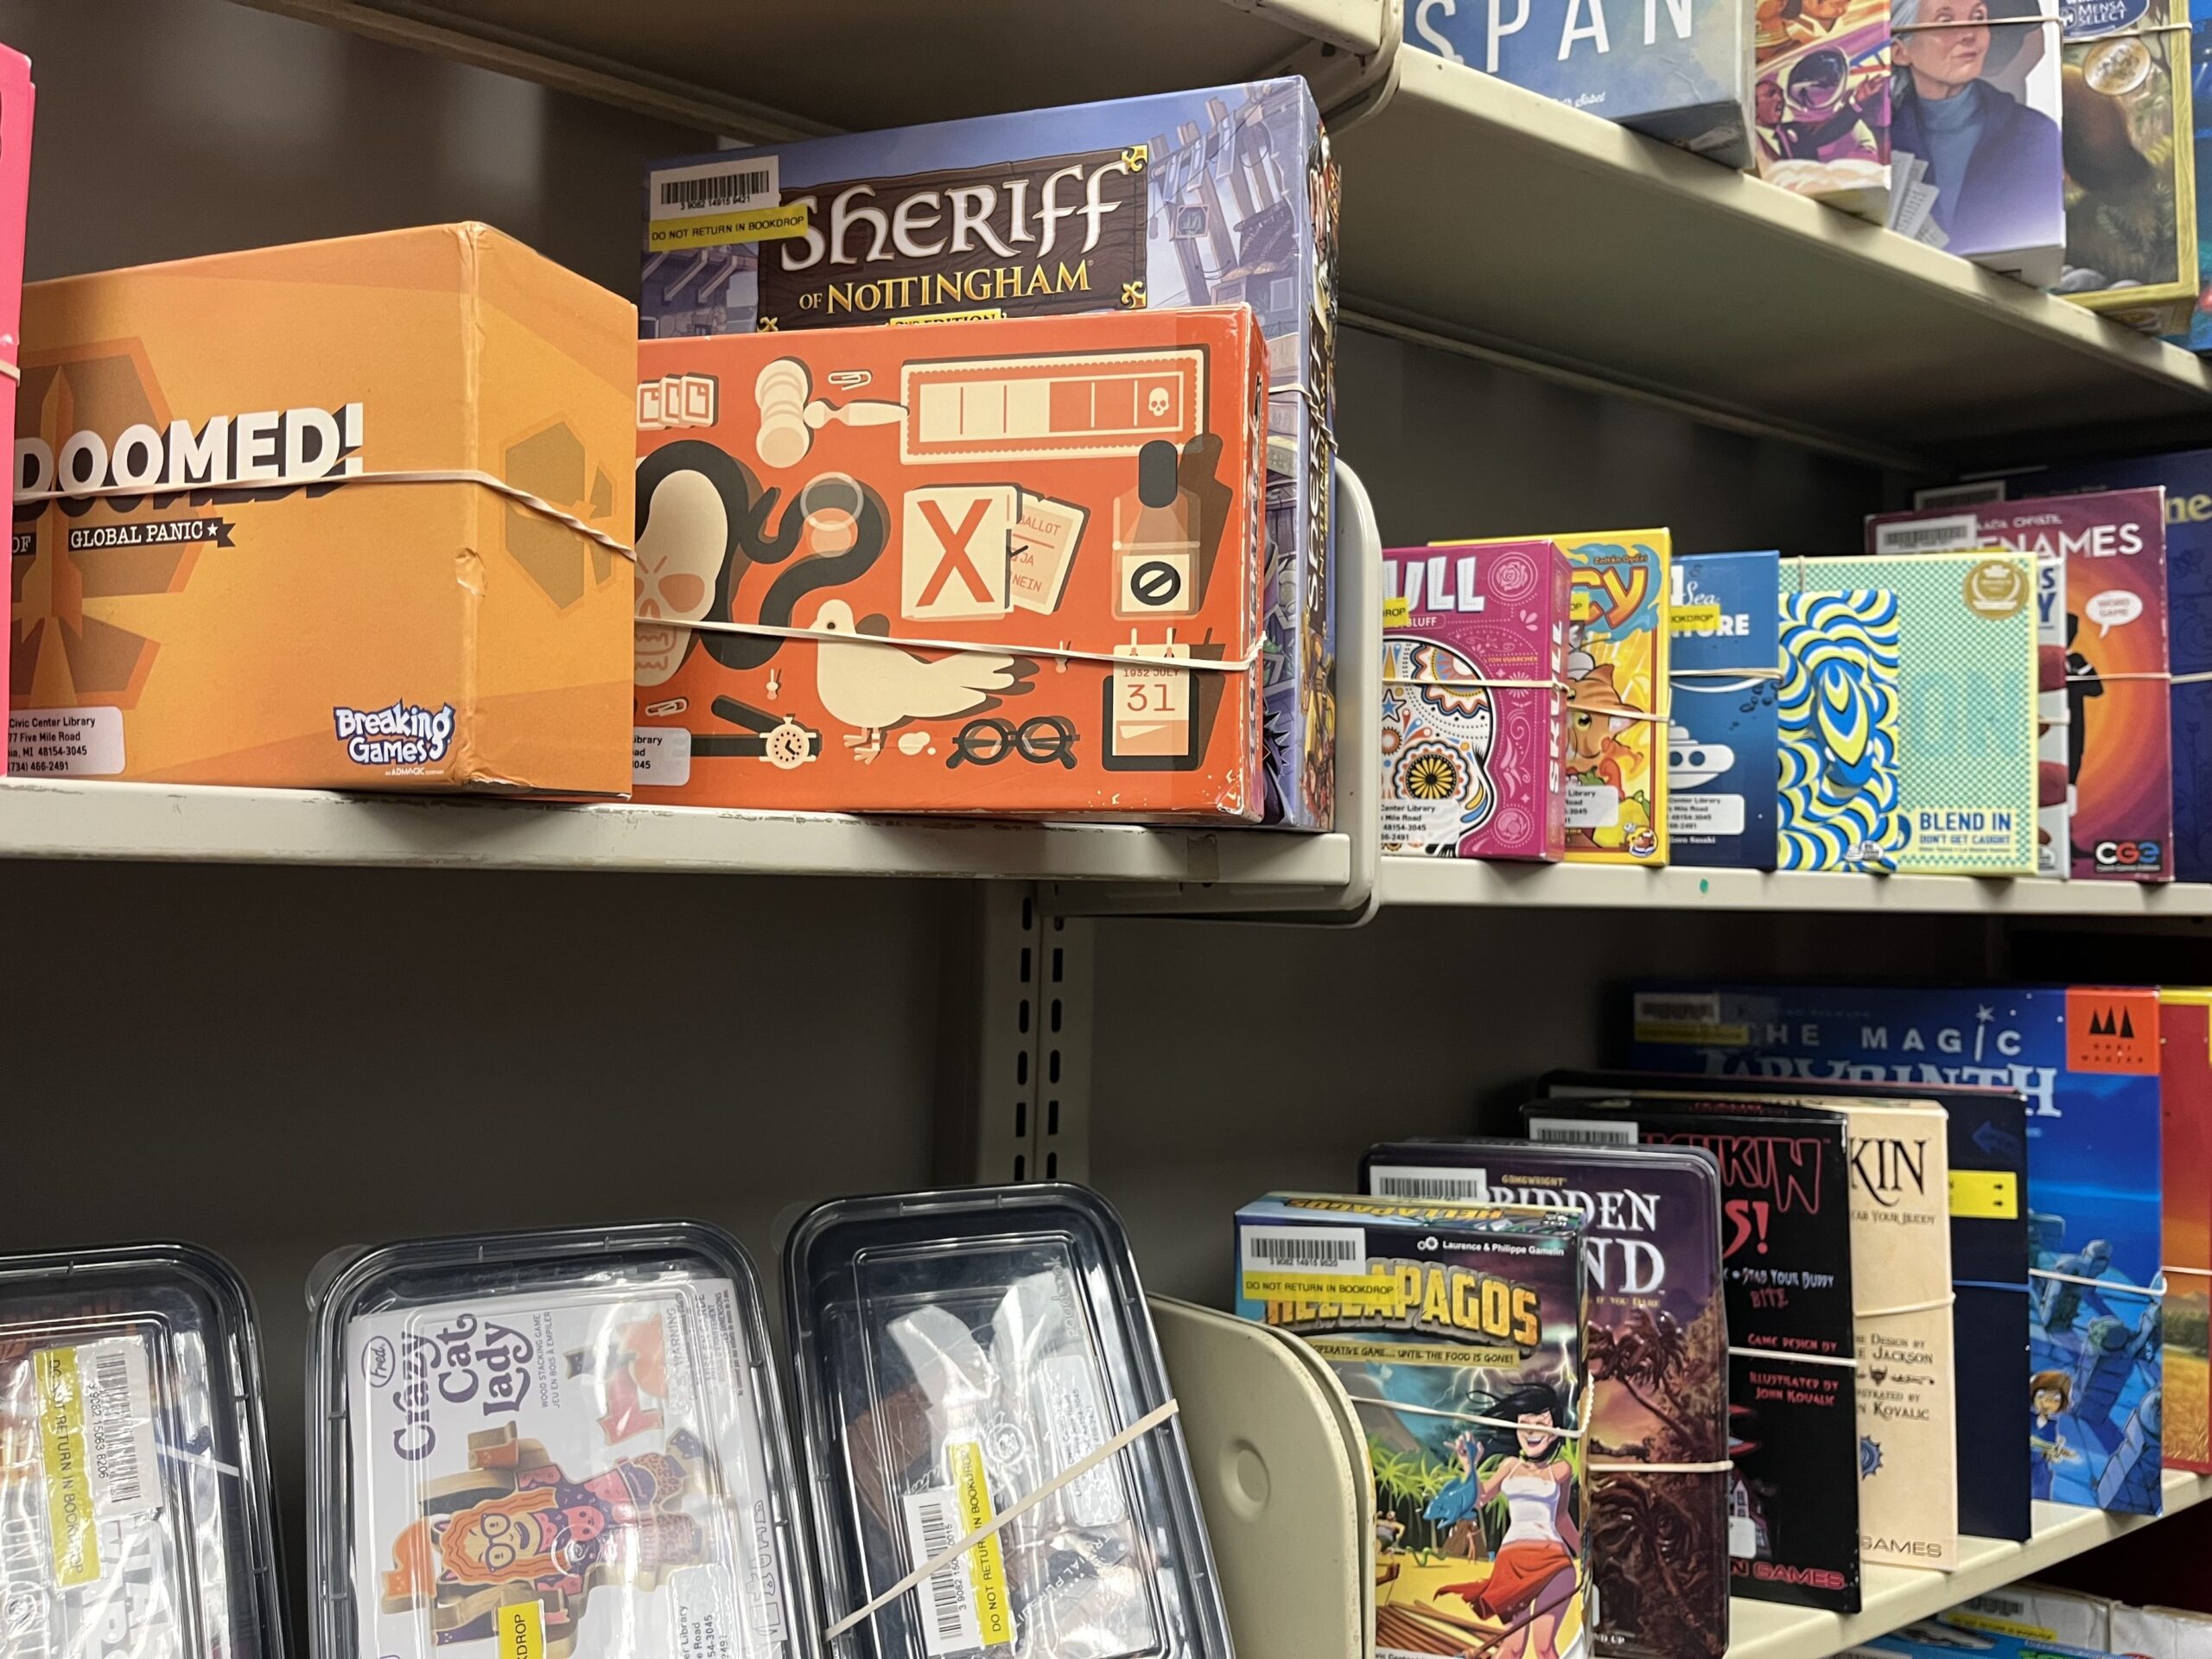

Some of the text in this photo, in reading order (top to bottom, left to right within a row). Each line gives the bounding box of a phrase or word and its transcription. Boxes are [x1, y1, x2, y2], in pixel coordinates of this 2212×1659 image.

[652, 232, 666, 240] DO
[670, 230, 688, 238] NOT
[692, 225, 733, 236] RETURN
[748, 216, 804, 230] BOOKDROP
[799, 259, 1092, 315] OF NOTTINGHAM
[13, 403, 364, 505] DOOMED!
[71, 525, 142, 549] GLOBAL
[146, 520, 203, 543] PANIC
[1020, 514, 1062, 537] BALLOT
[916, 499, 995, 607] X
[1020, 552, 1034, 566] JA
[1012, 573, 1042, 592] NEIN
[1686, 581, 1718, 605] Sea
[1408, 616, 1437, 627] BLUFF
[1123, 668, 1179, 677] 1932 JULY
[1127, 683, 1176, 711] 31
[10, 716, 95, 728] Civic Center Library
[334, 698, 454, 760] Breaking
[20, 731, 80, 742] Five Mile Road
[23, 746, 86, 757] MI 48154-3045
[348, 736, 427, 764] Games
[31, 762, 68, 771] 466-2491
[1920, 812, 2011, 830] BLEND IN
[1950, 834, 1968, 844] GET
[1973, 834, 2011, 844] CAUGHT
[1861, 1018, 2023, 1063] MAGIC
[1643, 1133, 1821, 1214] KIN
[1850, 1136, 1927, 1207] KIN
[1442, 1240, 1564, 1256] Laurence & Philippe Gamelin
[1246, 1281, 1259, 1290] DO
[1285, 1283, 1323, 1292] RETURN
[1326, 1284, 1336, 1293] IN
[1339, 1284, 1394, 1294] BOOKDROP
[1770, 1269, 1799, 1286] YOUR
[1751, 1288, 1789, 1308] BITE
[543, 1312, 554, 1346] EMPILER
[667, 1307, 683, 1366] WARNING
[370, 1347, 387, 1379] Fred
[435, 1313, 479, 1403] Cat
[533, 1314, 549, 1408] WOOD STACKING GAME
[548, 1357, 556, 1376] BOIS
[1361, 1346, 1395, 1357] GAME...
[1397, 1350, 1423, 1358] UNTIL
[1427, 1351, 1443, 1359] THE
[1445, 1352, 1470, 1361] FOOD
[1473, 1352, 1481, 1361] IS
[1484, 1354, 1513, 1363] GONE!
[1872, 1345, 1933, 1364] JACKSON
[475, 1321, 533, 1416] Lady
[392, 1331, 441, 1461] Crazy
[551, 1379, 557, 1389] EN
[1756, 1387, 1835, 1407] JOHN KOVALIC
[1873, 1402, 1929, 1421] KOVALIC
[54, 1416, 72, 1471] RETURN
[88, 1392, 109, 1479] 9082 15063 8206
[61, 1476, 74, 1489] IN
[959, 1449, 1001, 1631] DO NOT RETUR IN BOOKDROP
[1860, 1535, 1942, 1558] GAMES
[1753, 1560, 1847, 1590] GAMES
[954, 1579, 966, 1602] 9082
[679, 1605, 689, 1645] Library
[692, 1622, 702, 1649] Road
